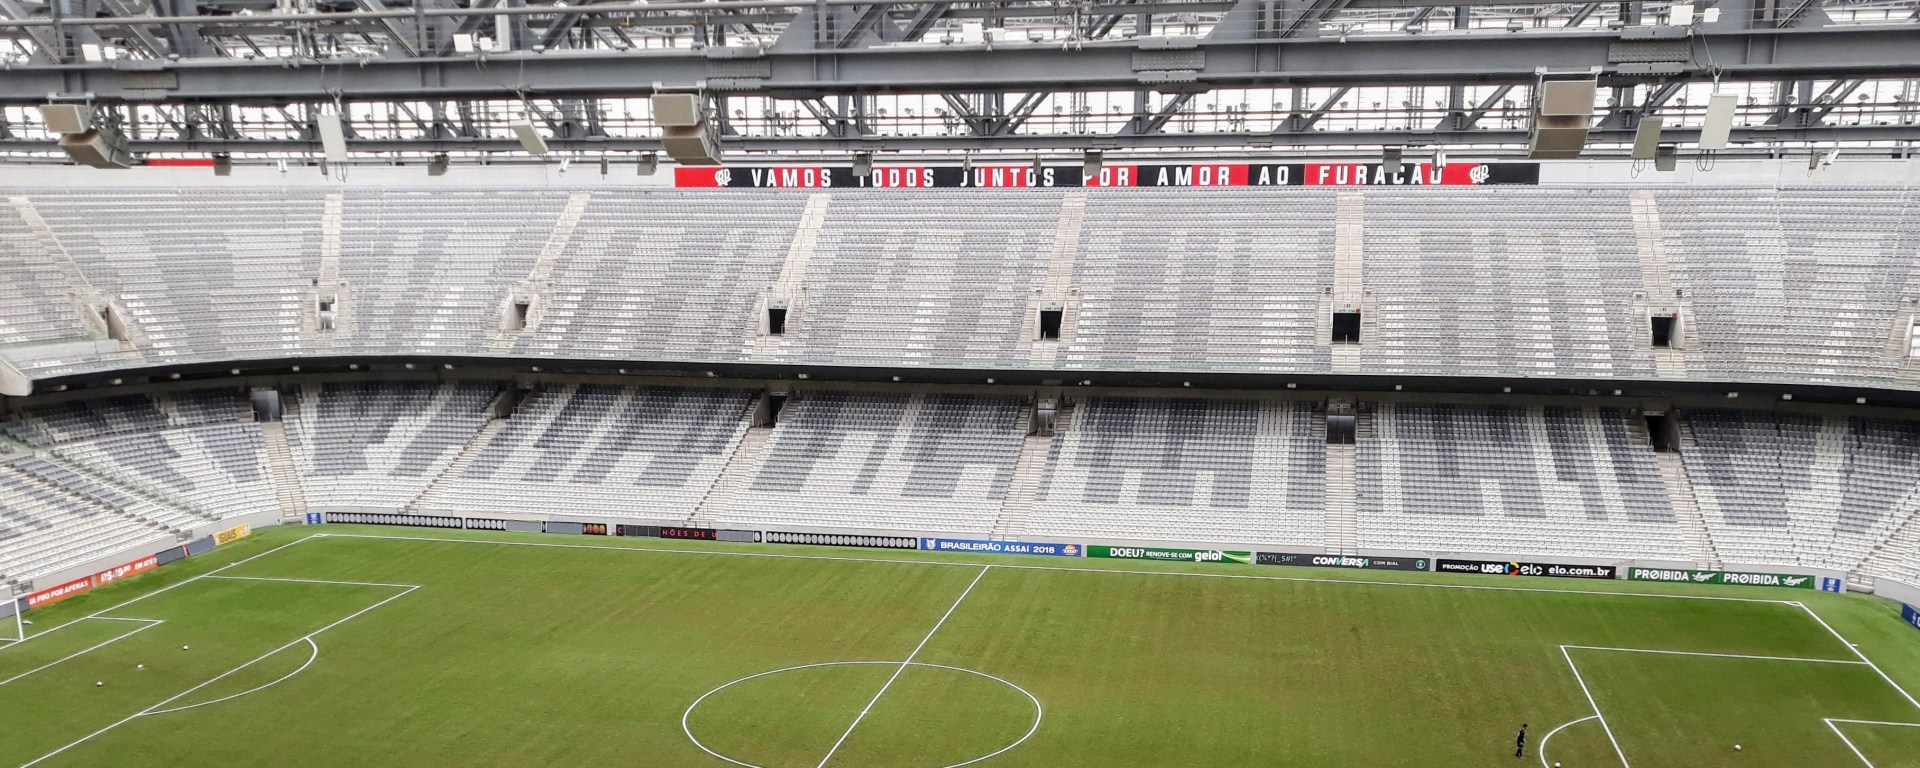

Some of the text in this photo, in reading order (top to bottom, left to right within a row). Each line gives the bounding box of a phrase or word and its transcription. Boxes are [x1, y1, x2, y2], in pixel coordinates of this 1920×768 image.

[751, 168, 832, 187] VAMOS
[960, 168, 1055, 187] JUNTOS
[1157, 166, 1230, 186] AMOR
[1258, 166, 1289, 185] AO
[940, 541, 1001, 552] BRASILEIRÃO
[1032, 545, 1055, 554] 2018
[1109, 547, 1145, 558] DOEU?
[1194, 549, 1223, 562] gelol
[1312, 556, 1370, 568] CONVERSA
[1442, 562, 1479, 572] PROMOÇÃO
[1548, 565, 1611, 577] elo.com.br
[37, 593, 50, 602] PRO
[51, 588, 64, 598] POR
